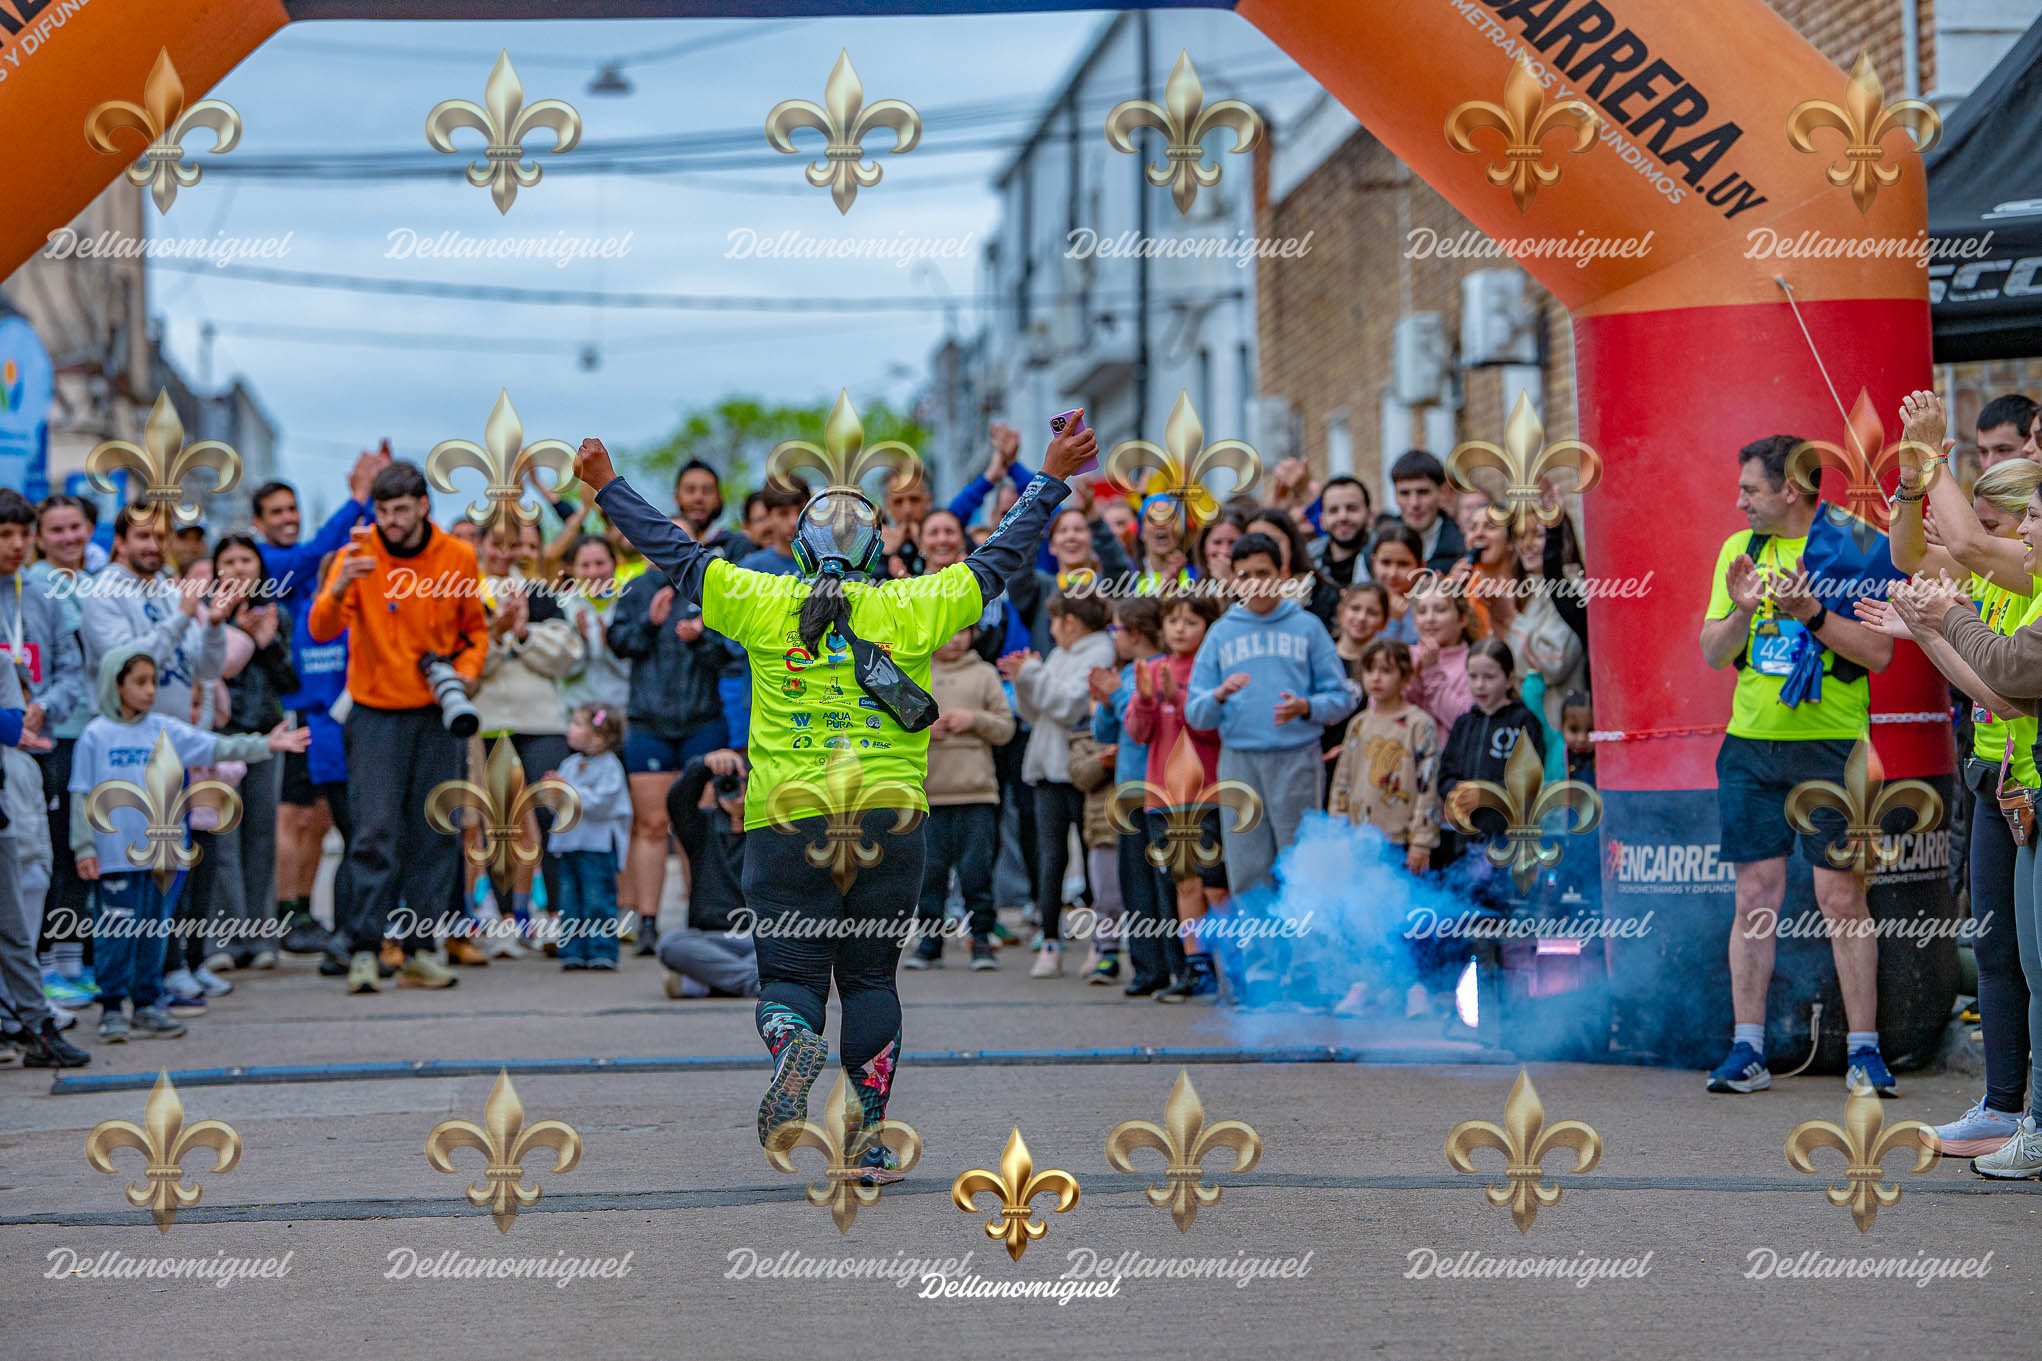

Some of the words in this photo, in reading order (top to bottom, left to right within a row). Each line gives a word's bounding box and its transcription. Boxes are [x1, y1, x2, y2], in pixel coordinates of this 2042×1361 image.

[4, 47, 20, 67] Y
[1555, 84, 1574, 100] Y
[1480, 0, 1769, 220] ARRERA.UY
[1220, 631, 1309, 671] MALIBU
[822, 712, 851, 720] AQUA
[826, 720, 854, 728] PURA
